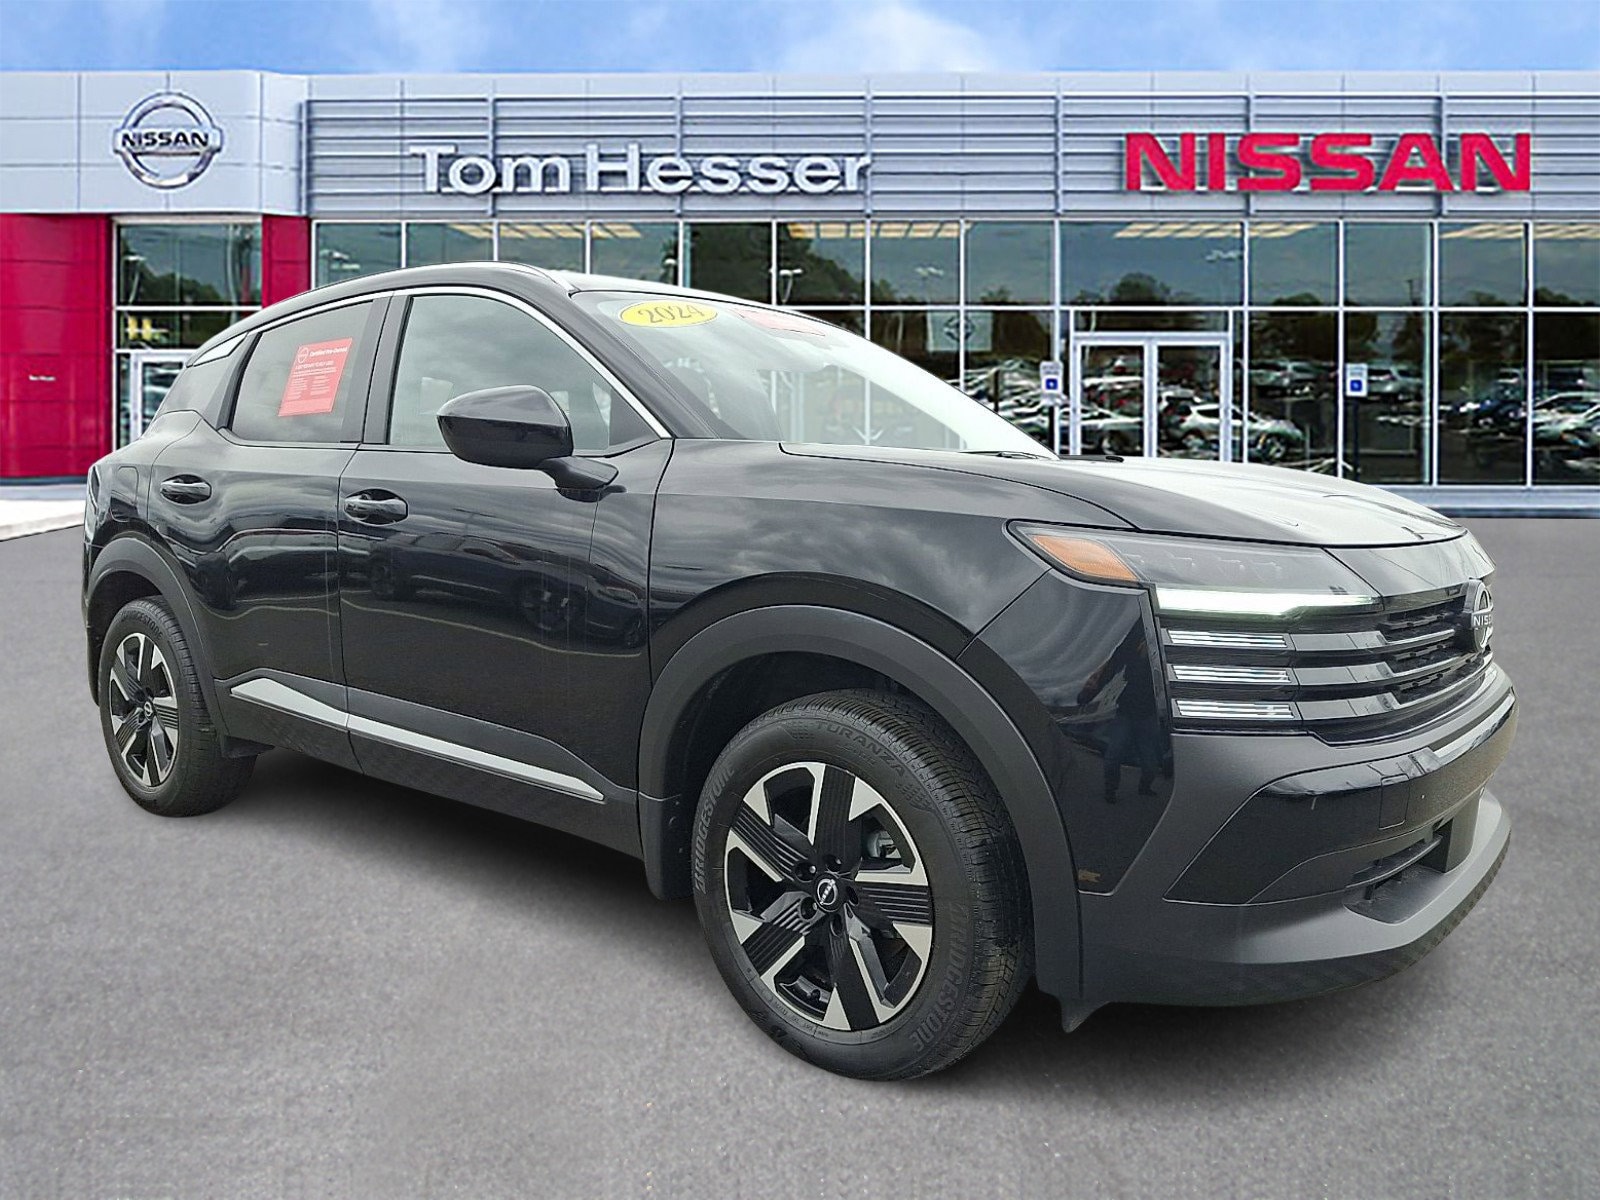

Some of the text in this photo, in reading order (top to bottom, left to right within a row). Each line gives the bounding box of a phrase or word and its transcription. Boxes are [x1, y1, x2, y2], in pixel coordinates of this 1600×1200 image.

[122, 131, 209, 147] NISSAN
[1125, 132, 1531, 191] NISSAN
[409, 143, 872, 194] Tom Hesser
[637, 304, 705, 323] 2024
[816, 720, 906, 777] TURANZA
